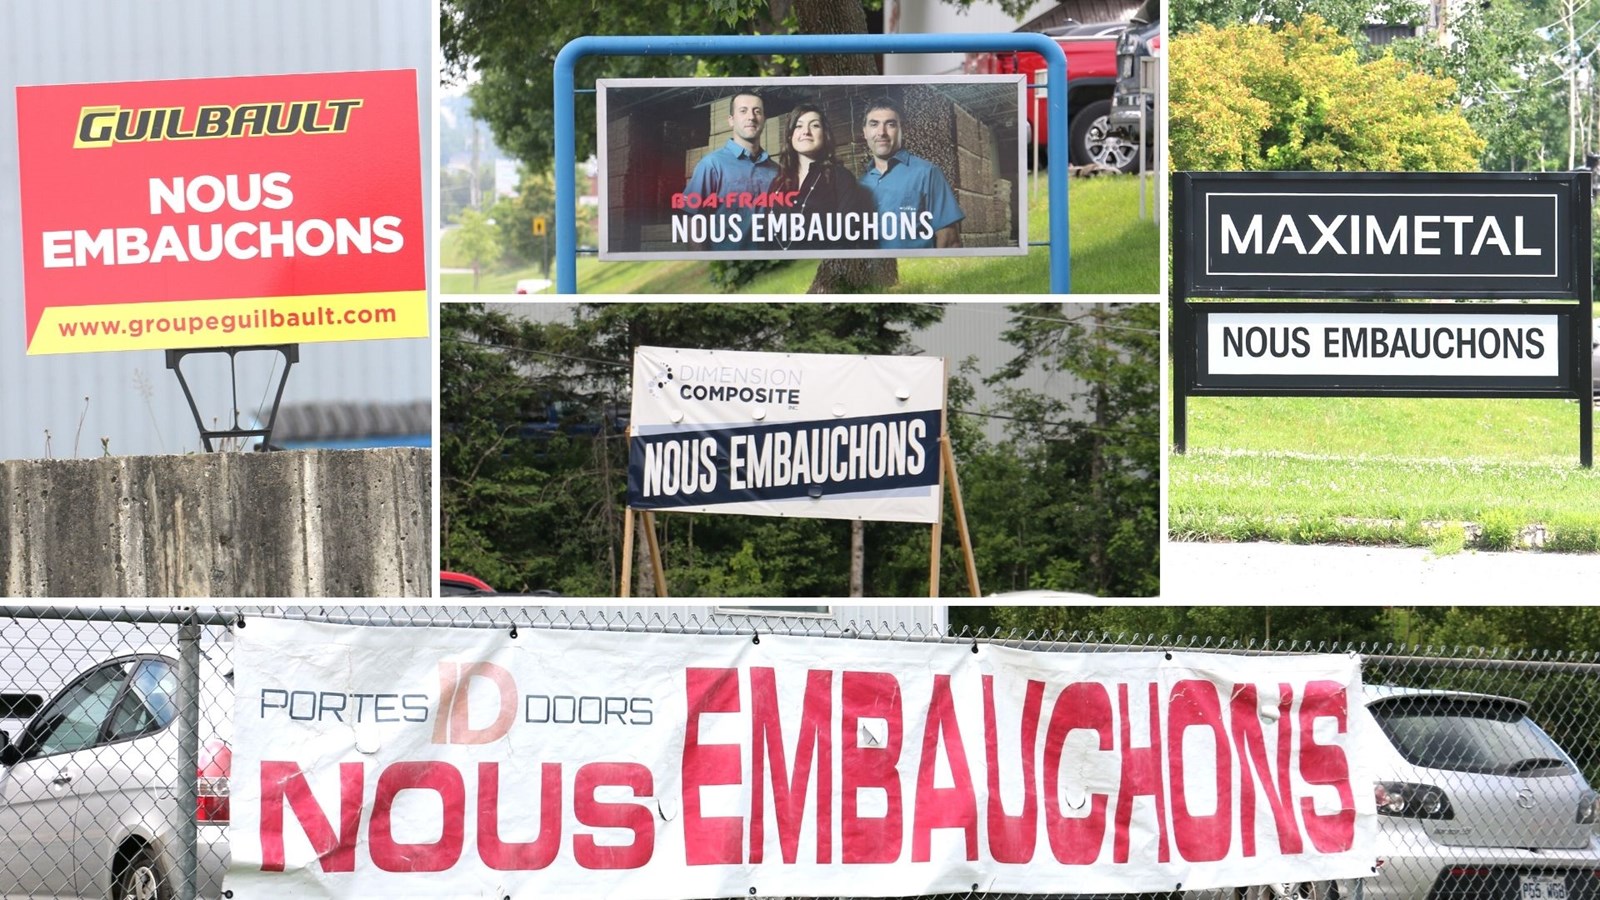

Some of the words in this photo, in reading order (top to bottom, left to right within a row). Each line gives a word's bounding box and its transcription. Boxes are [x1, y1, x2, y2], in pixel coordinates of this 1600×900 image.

[75, 99, 363, 147] GUILBAULT
[149, 172, 294, 215] NOUS
[671, 191, 800, 209] BOA-FRANC
[42, 215, 404, 268] EMBAUCHONS
[671, 213, 743, 244] NOUS
[751, 211, 934, 242] EMBAUCHONS
[1221, 214, 1542, 255] MAXIMETAL
[59, 307, 397, 337] www.groupeguilbault.com
[1223, 326, 1311, 358] NOUS
[1324, 327, 1545, 359] EMBAUCHONS
[680, 365, 803, 386] DIMENSION
[680, 384, 801, 405] COMPOSITE
[643, 437, 717, 497] NOUS
[730, 418, 926, 490] EMBAUCHONS
[260, 688, 428, 724] PORTES
[431, 661, 518, 745] ID
[525, 695, 653, 725] DOORS
[260, 760, 655, 873] NOUS
[682, 667, 1355, 866] EMBAUCHONS
